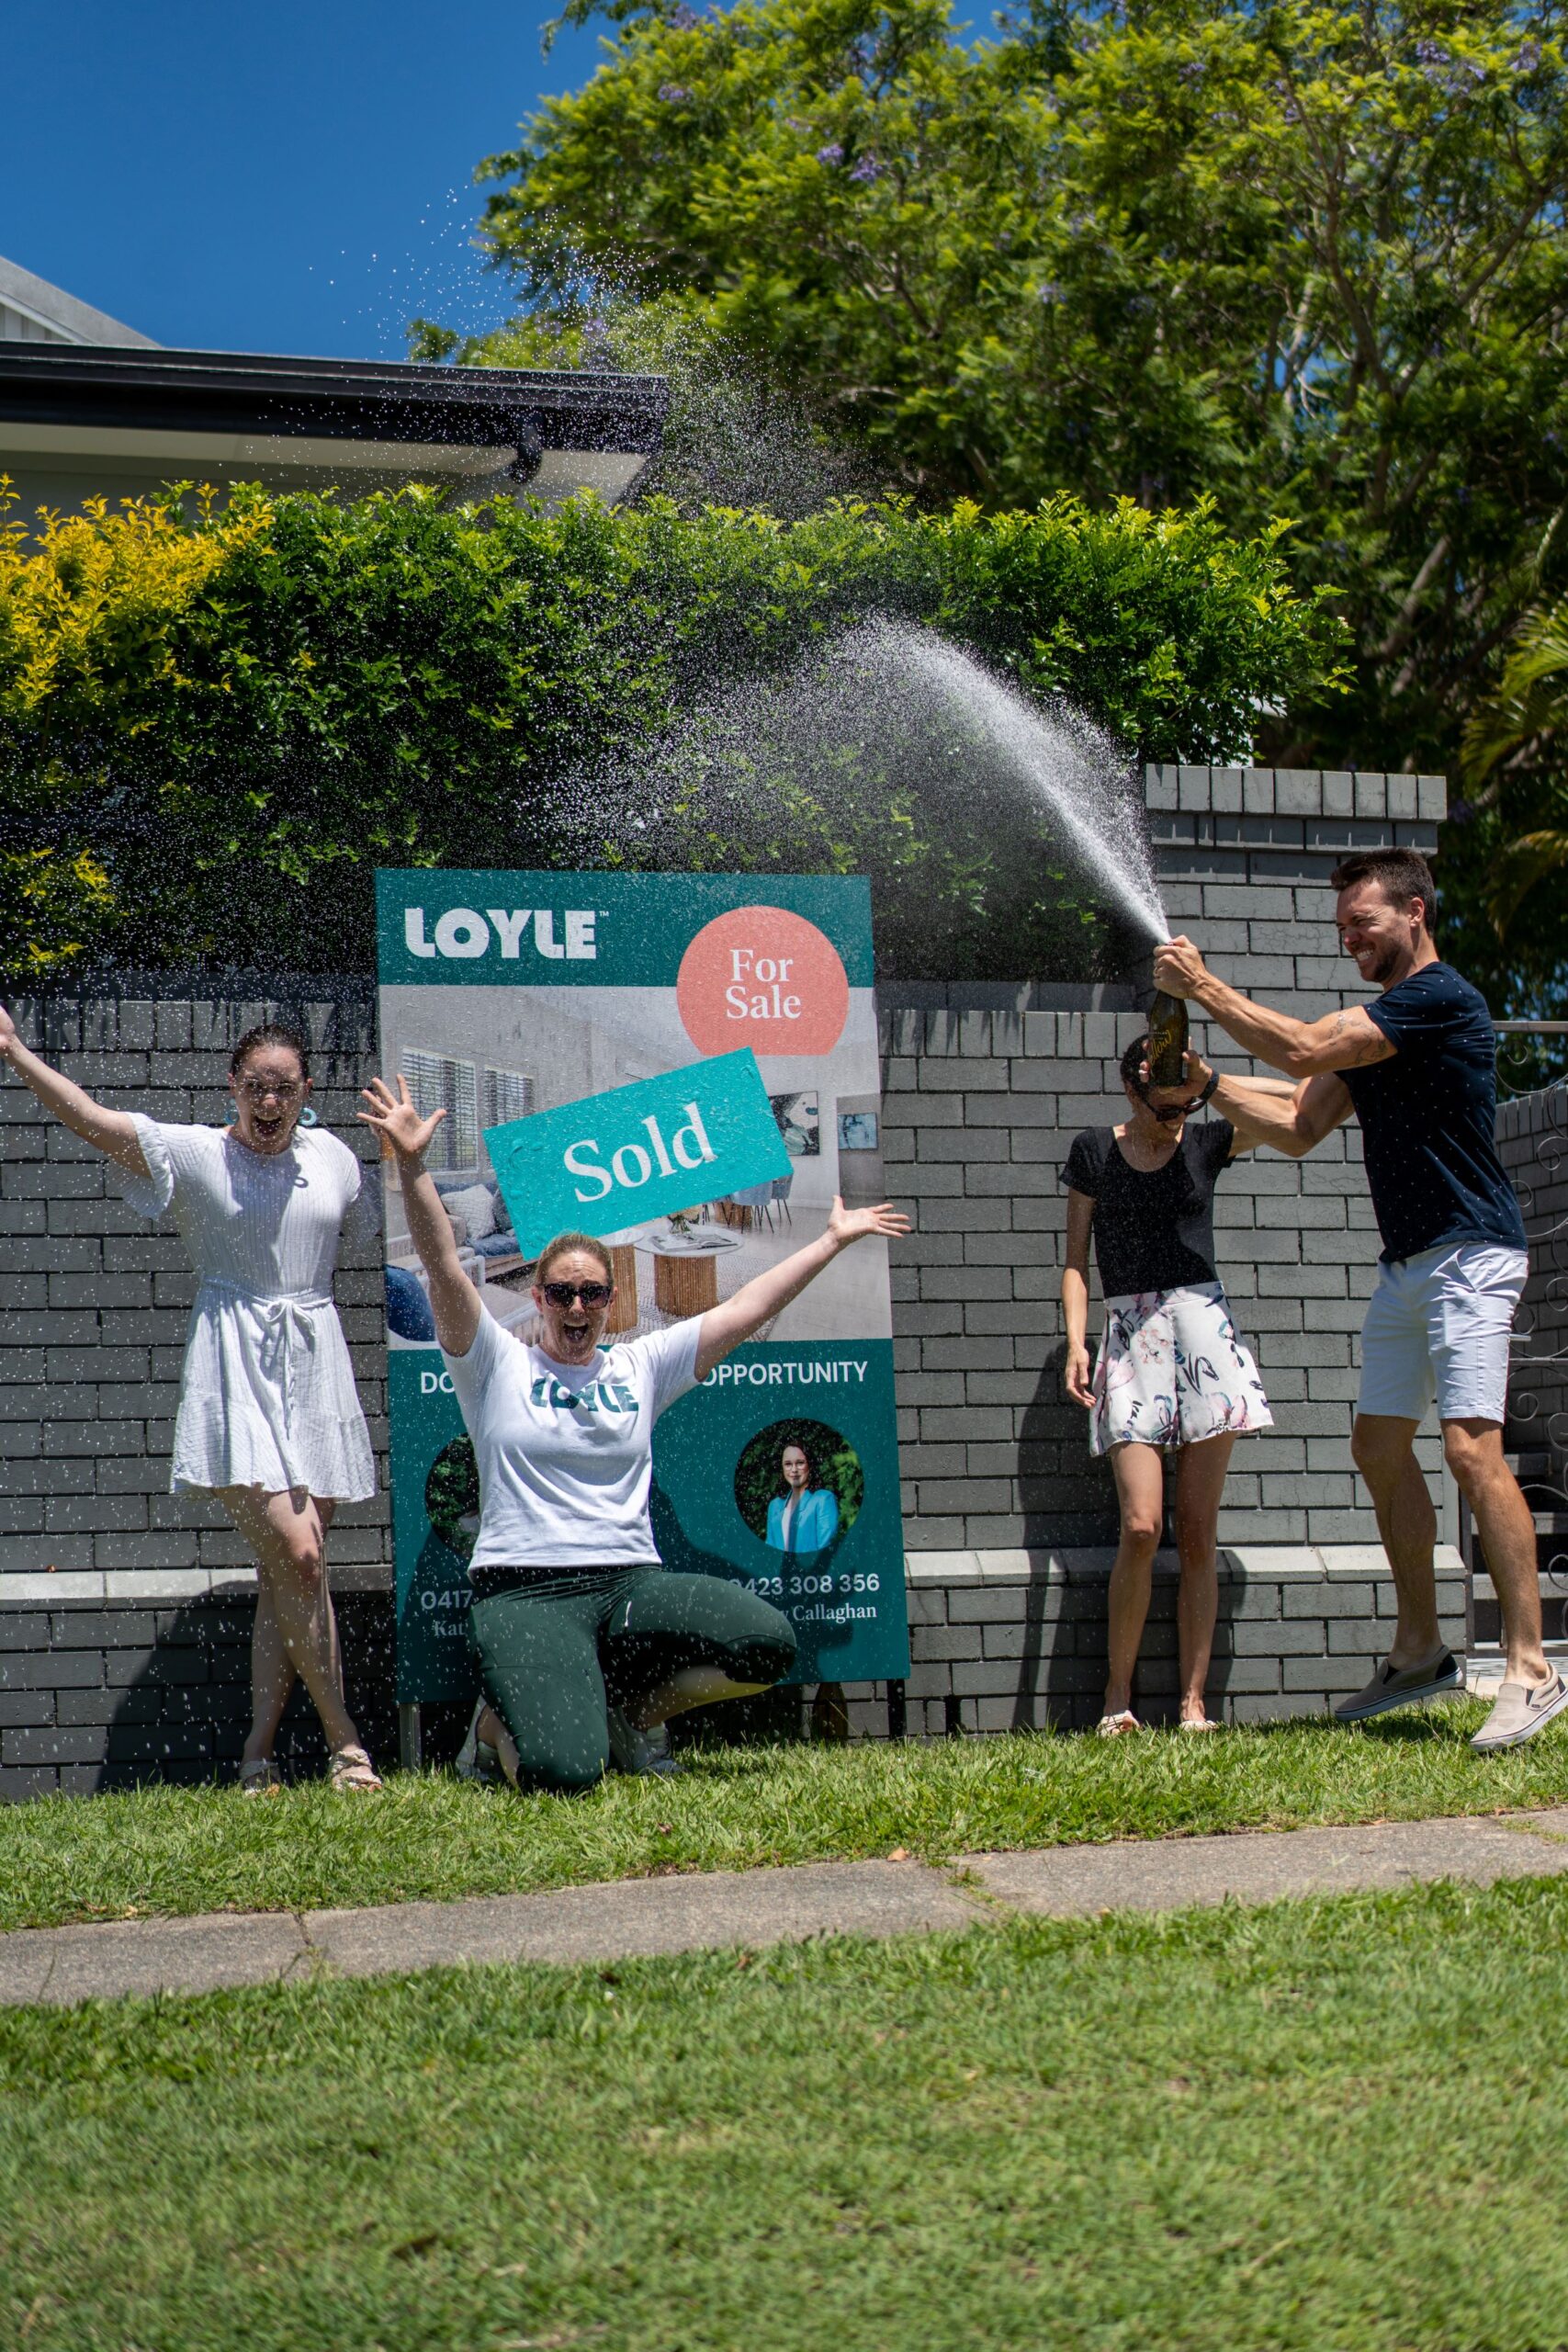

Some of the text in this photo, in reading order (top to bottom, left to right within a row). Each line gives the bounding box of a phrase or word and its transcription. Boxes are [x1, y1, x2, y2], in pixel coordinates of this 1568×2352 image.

[405, 908, 596, 959] LOYLE
[730, 949, 794, 982] For
[725, 984, 801, 1019] Sale
[563, 1102, 718, 1202] Sold
[421, 1589, 473, 1610] 0417
[790, 1575, 832, 1594] 308
[839, 1573, 880, 1592] 356
[793, 1603, 877, 1623] Callaghan
